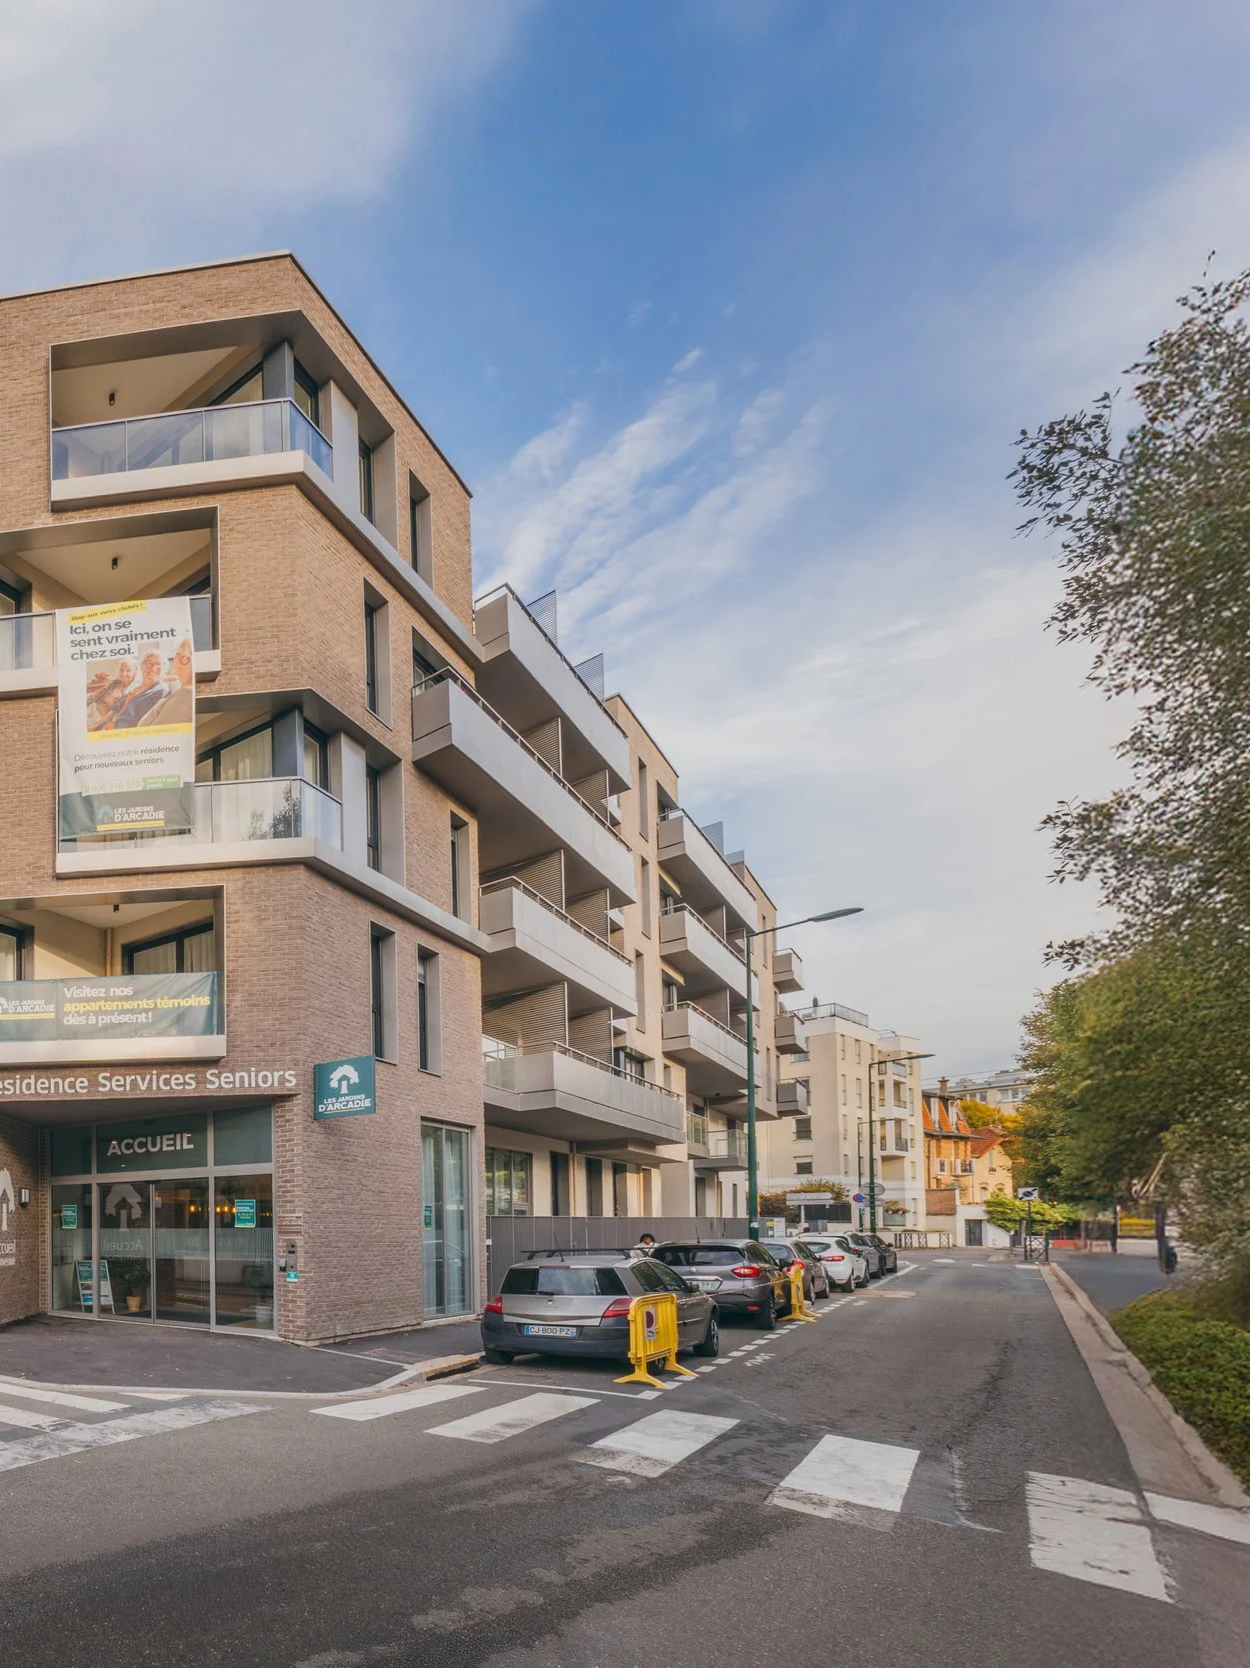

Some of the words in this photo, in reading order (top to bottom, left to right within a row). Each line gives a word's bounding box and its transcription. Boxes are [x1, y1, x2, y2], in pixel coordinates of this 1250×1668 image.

[70, 623, 90, 635] Ici,
[92, 623, 112, 632] on
[115, 620, 132, 630] se
[70, 637, 104, 648] sent
[106, 627, 177, 644] vraiment
[71, 648, 107, 661] chez
[110, 644, 134, 656] soi.
[74, 752, 116, 761] Découvrez
[141, 746, 179, 754] résidence
[75, 764, 92, 774] pour
[95, 760, 133, 769] nouveaux
[115, 811, 165, 822] D'ARCADIE
[64, 986, 106, 998] Visitez
[110, 986, 133, 996] nos
[9, 1004, 54, 1013] D'ARCADIE
[64, 998, 154, 1012] appartements
[156, 995, 210, 1008] témoins
[64, 1013, 86, 1025] dès
[89, 1012, 96, 1024] à
[98, 1012, 145, 1026] présent
[98, 1070, 196, 1092] Services
[206, 1068, 296, 1089] Seniors
[337, 1094, 365, 1102] JARDINS
[319, 1099, 371, 1112] D'ARCADIE
[107, 1132, 194, 1156] ACCUEIL
